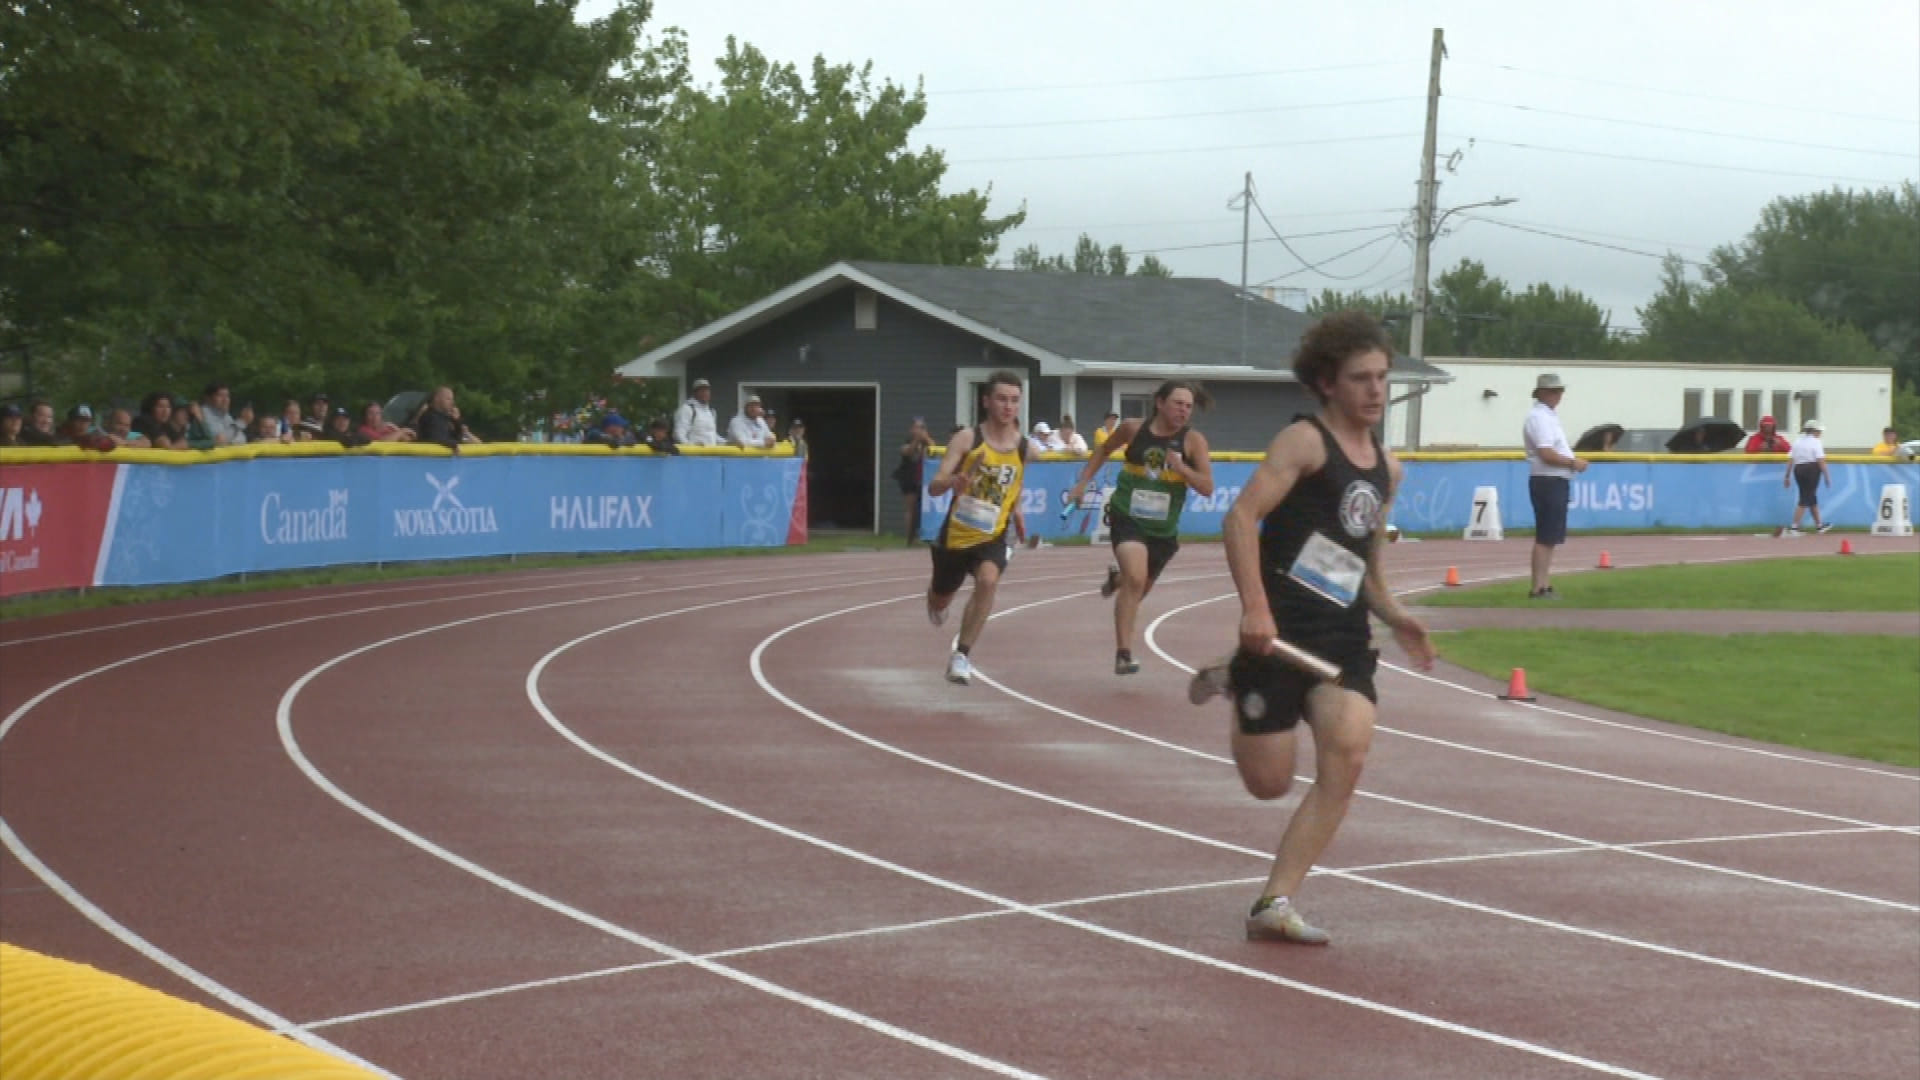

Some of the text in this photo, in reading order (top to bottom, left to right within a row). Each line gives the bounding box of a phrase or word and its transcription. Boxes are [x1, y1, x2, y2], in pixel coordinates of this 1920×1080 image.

[261, 491, 348, 544] Canada
[394, 507, 498, 536] NOVA SCOTIA
[551, 496, 652, 528] HALIFAX
[1475, 501, 1488, 523] 7
[1881, 498, 1893, 520] 6
